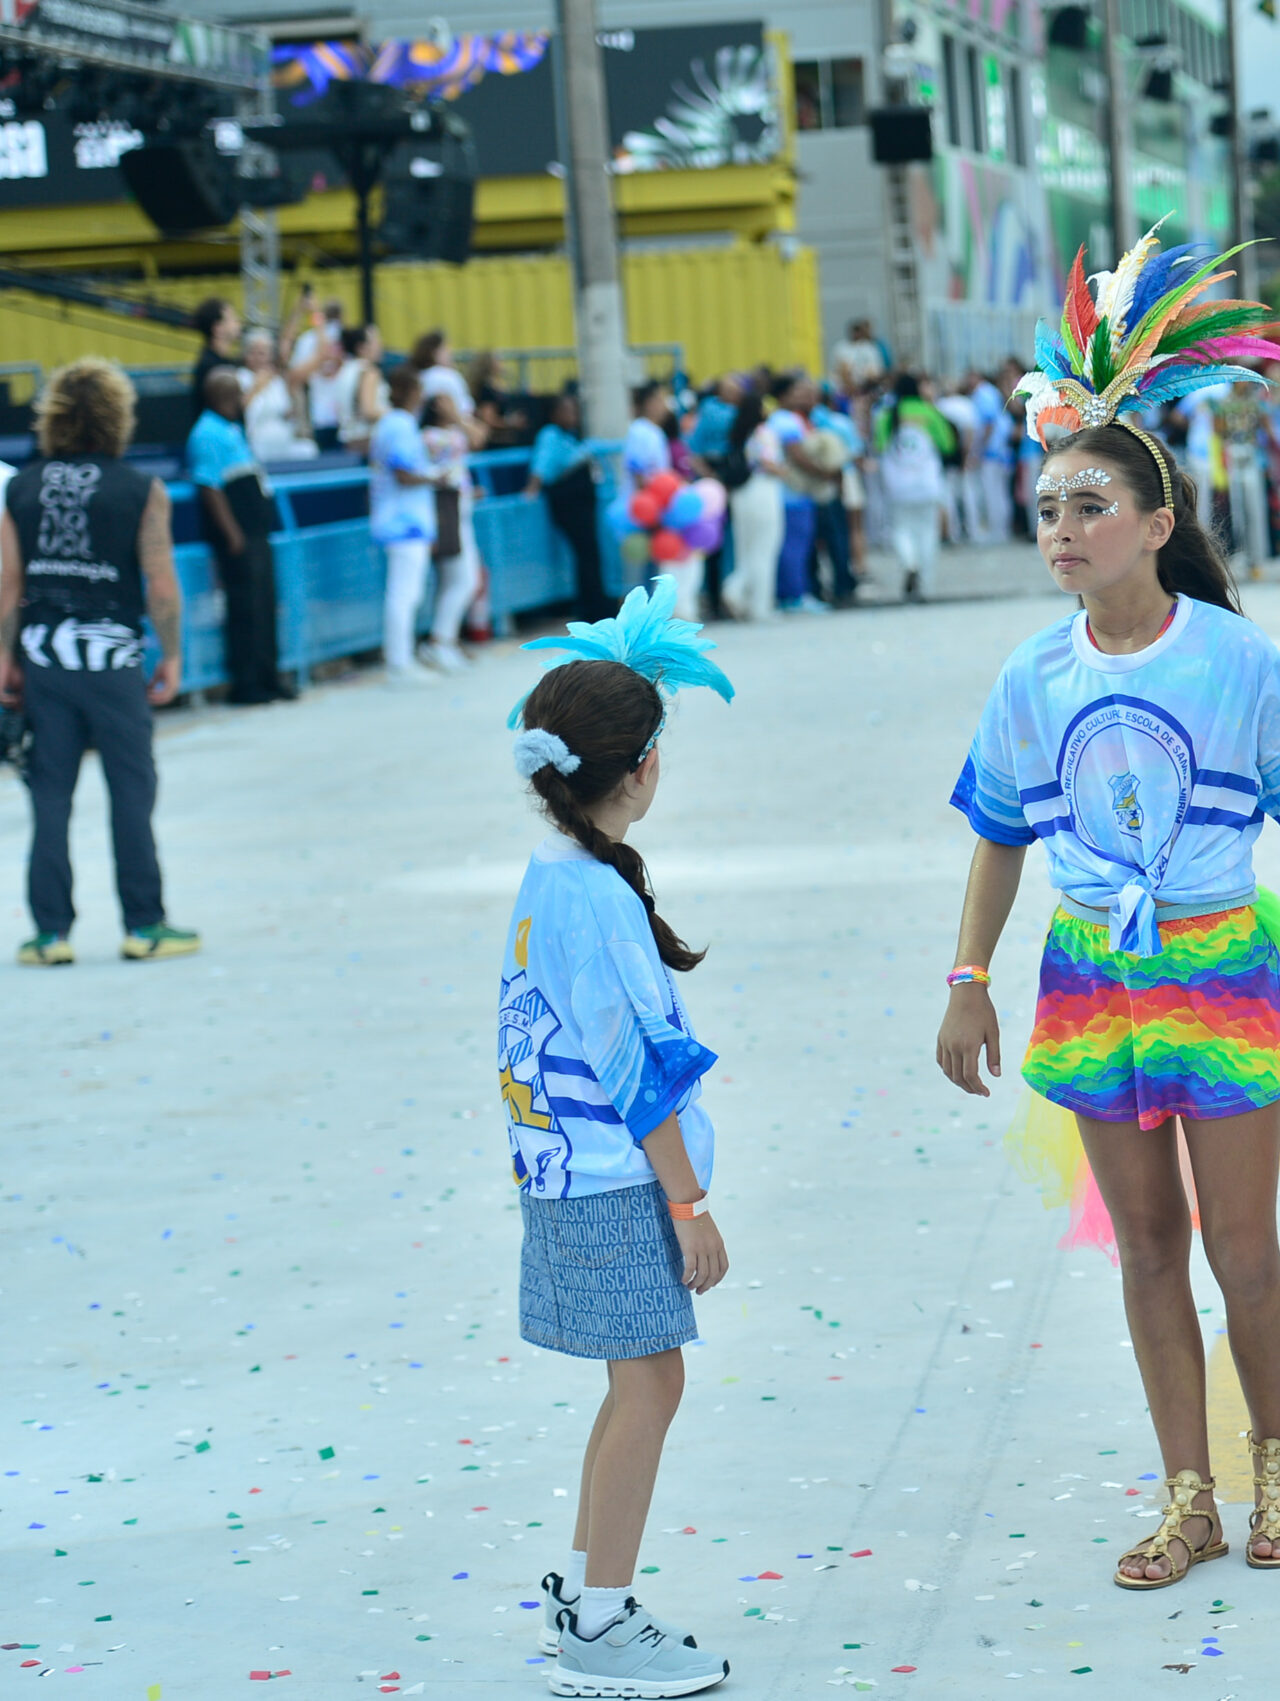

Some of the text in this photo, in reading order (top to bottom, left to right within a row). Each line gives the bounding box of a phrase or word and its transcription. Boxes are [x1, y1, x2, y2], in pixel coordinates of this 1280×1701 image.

[1064, 729, 1086, 790] RECREATIVO
[1125, 711, 1160, 735] ESCOLA
[1160, 731, 1175, 747] DE
